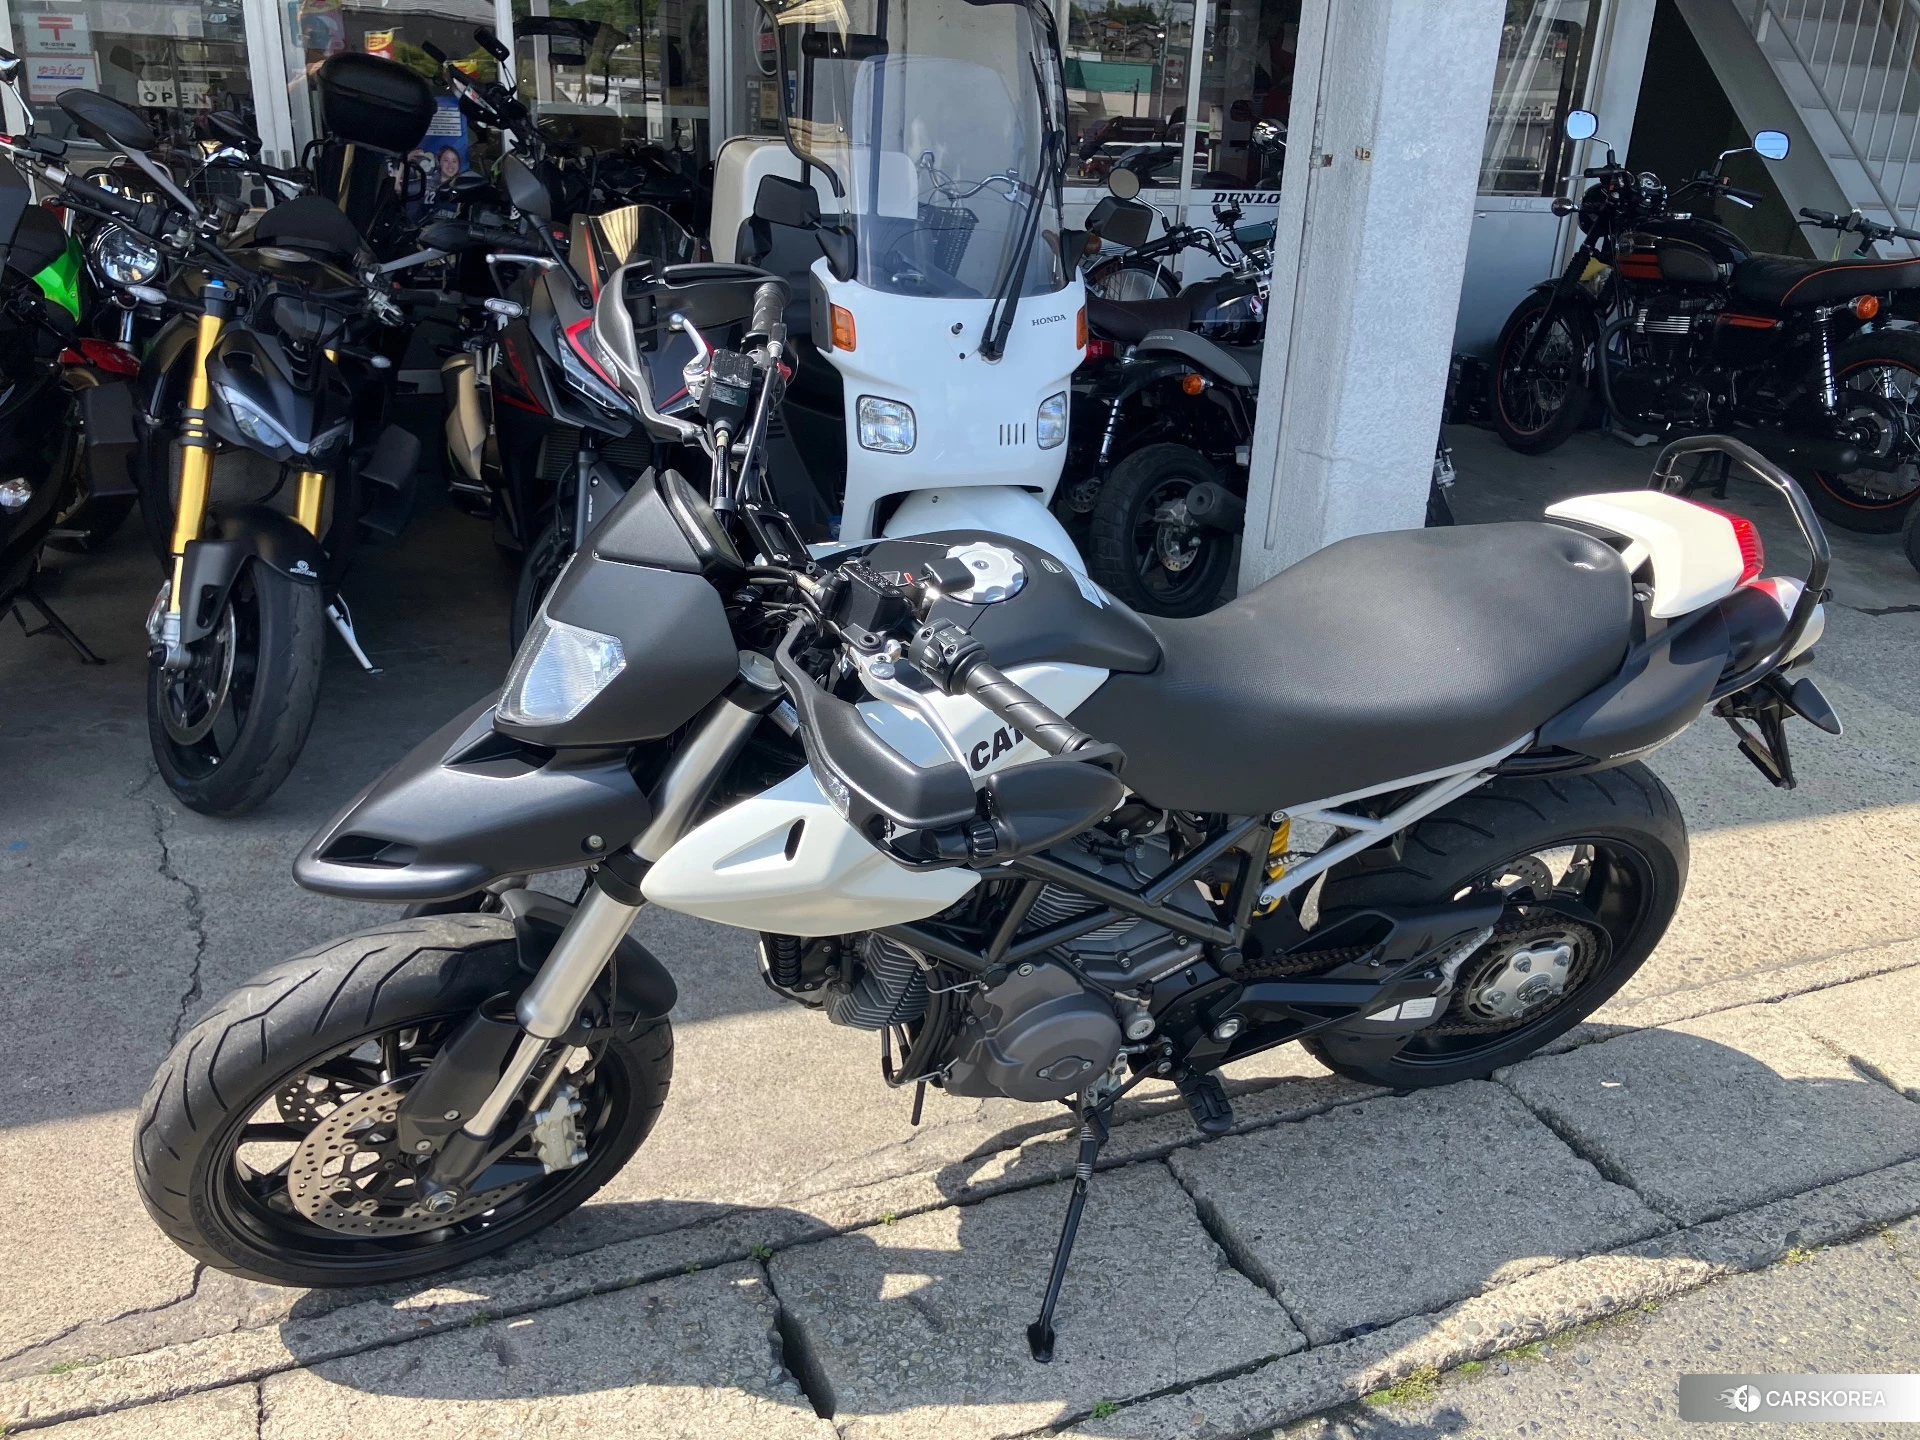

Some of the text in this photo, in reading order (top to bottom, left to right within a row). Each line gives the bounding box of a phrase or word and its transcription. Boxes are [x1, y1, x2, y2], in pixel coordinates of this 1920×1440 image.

[143, 91, 207, 105] OPEN
[1211, 192, 1281, 204] DUNLO
[1031, 314, 1067, 326] HONDA
